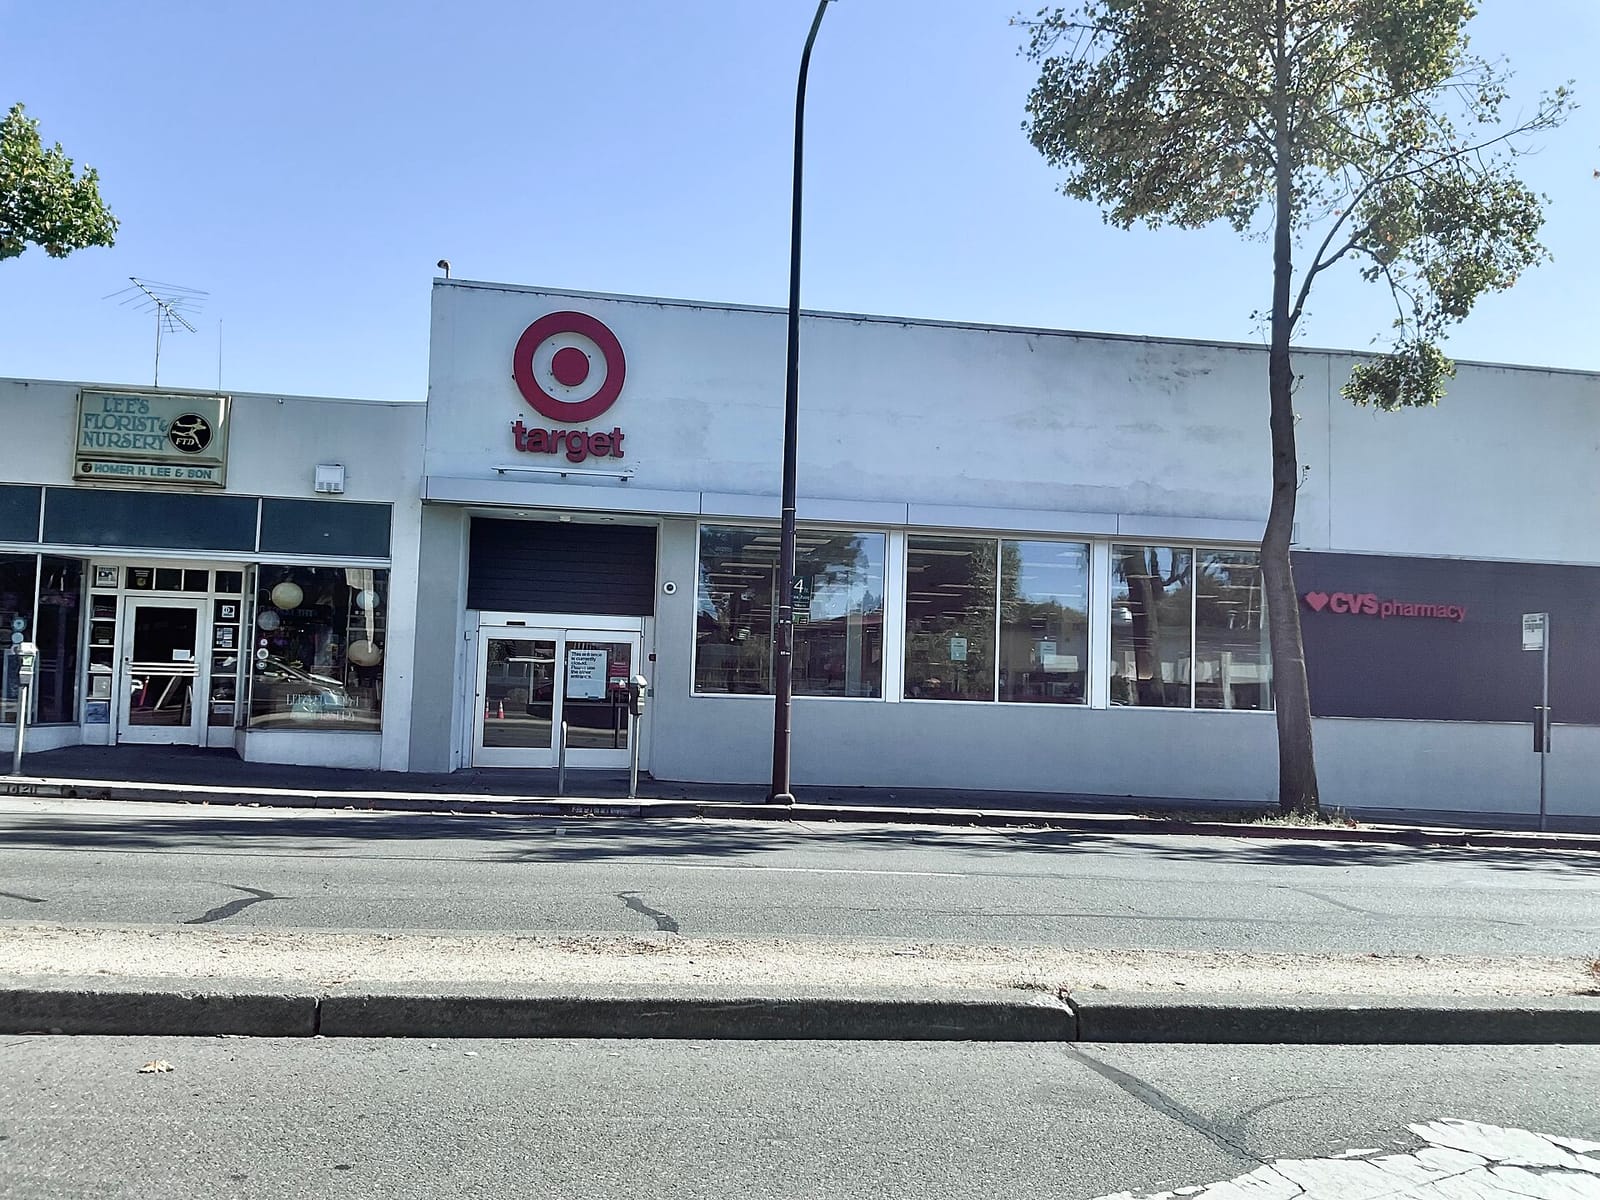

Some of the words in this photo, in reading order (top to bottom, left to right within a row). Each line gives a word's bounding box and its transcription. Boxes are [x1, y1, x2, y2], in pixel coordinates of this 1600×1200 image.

[103, 397, 150, 414] LEE'S
[83, 413, 160, 432] FLORIST
[159, 419, 168, 433] &
[83, 431, 169, 450] NURSERY
[175, 437, 195, 446] FTD
[512, 420, 625, 463] target
[94, 464, 134, 476] HOMER
[150, 467, 171, 477] LEE
[175, 469, 184, 478] &
[187, 469, 212, 480] SON
[793, 579, 804, 593] 4
[1330, 592, 1379, 615] CVS
[1380, 599, 1467, 622] pharmacy
